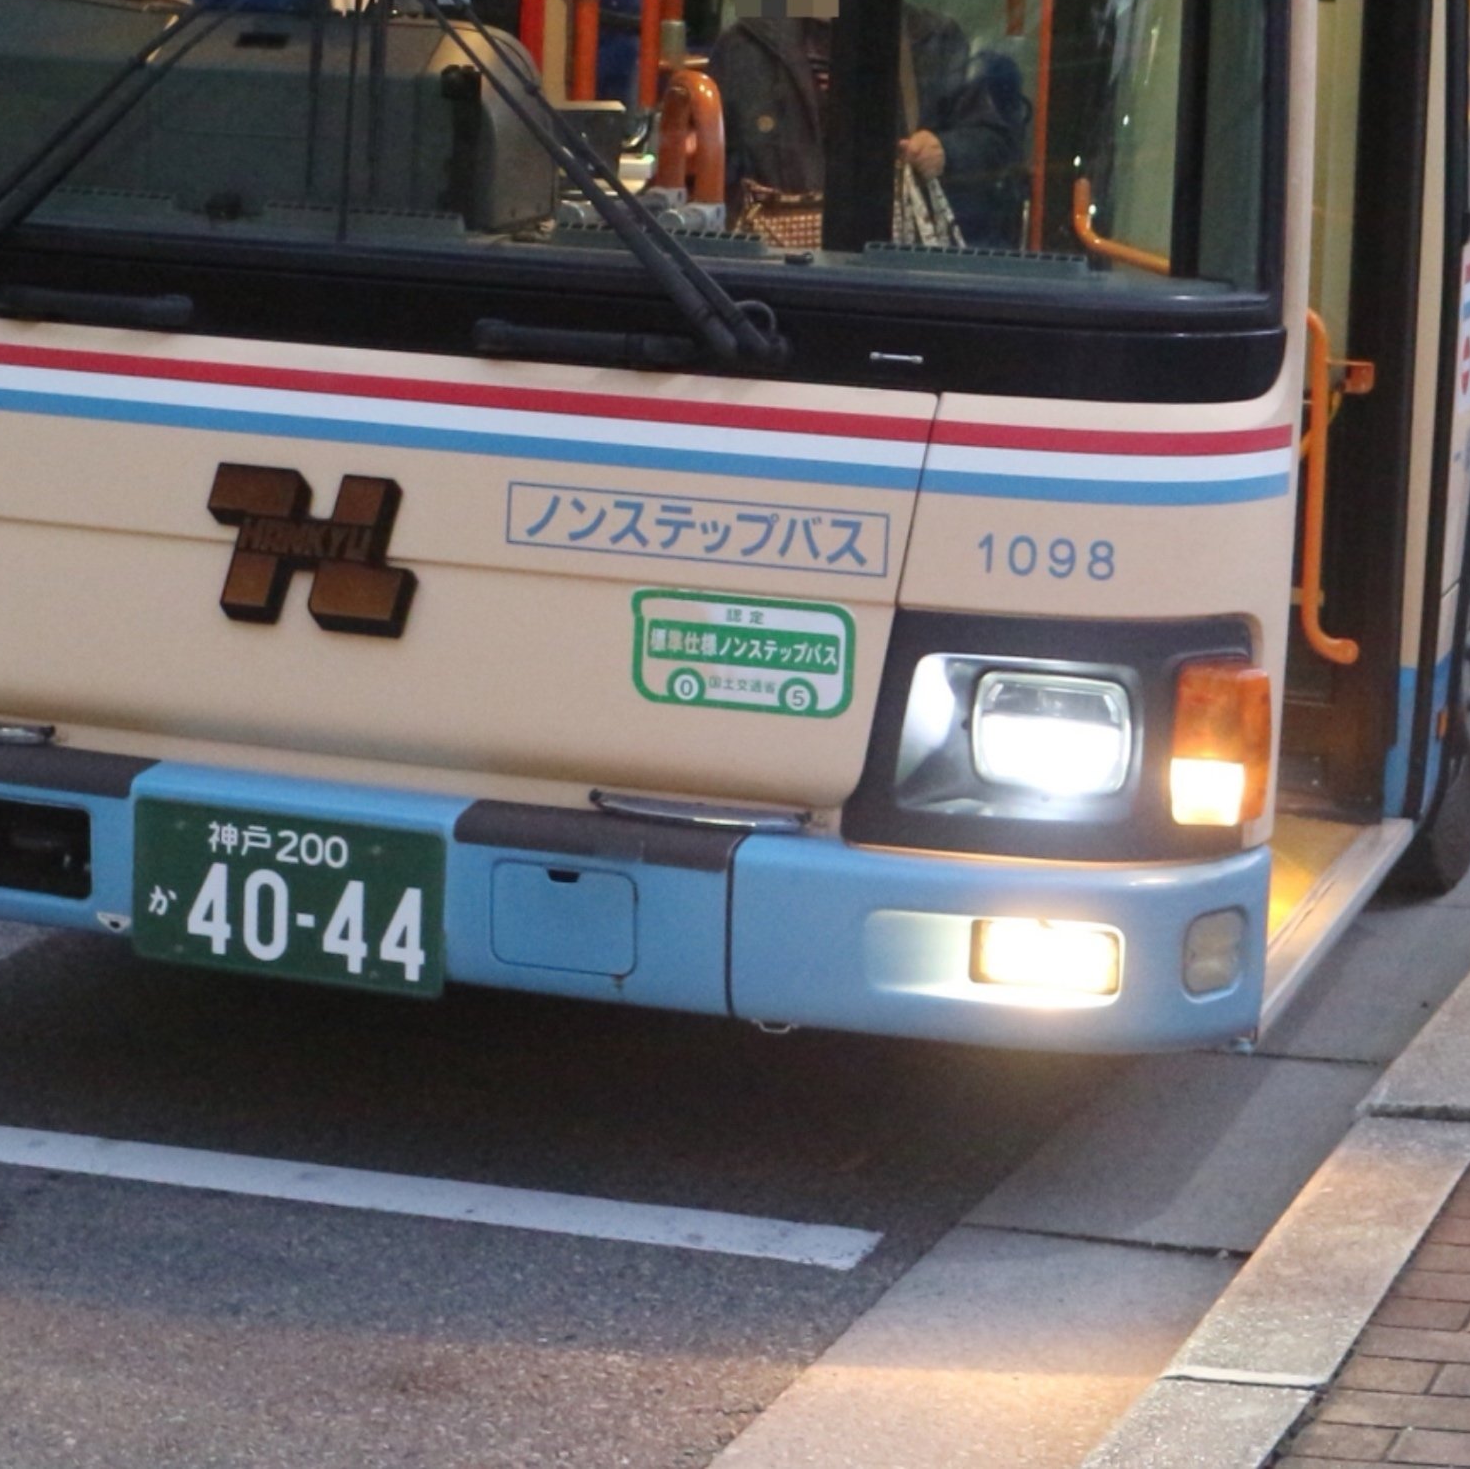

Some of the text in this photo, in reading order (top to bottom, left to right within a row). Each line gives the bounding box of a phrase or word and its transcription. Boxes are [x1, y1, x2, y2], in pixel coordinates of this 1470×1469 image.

[526, 495, 867, 568] ノンステップバス
[977, 534, 1116, 581] 1098
[726, 608, 765, 625] 認定
[708, 675, 776, 694] 国土交通省
[208, 820, 349, 869] 神戸200
[148, 862, 425, 982] か 40-44
